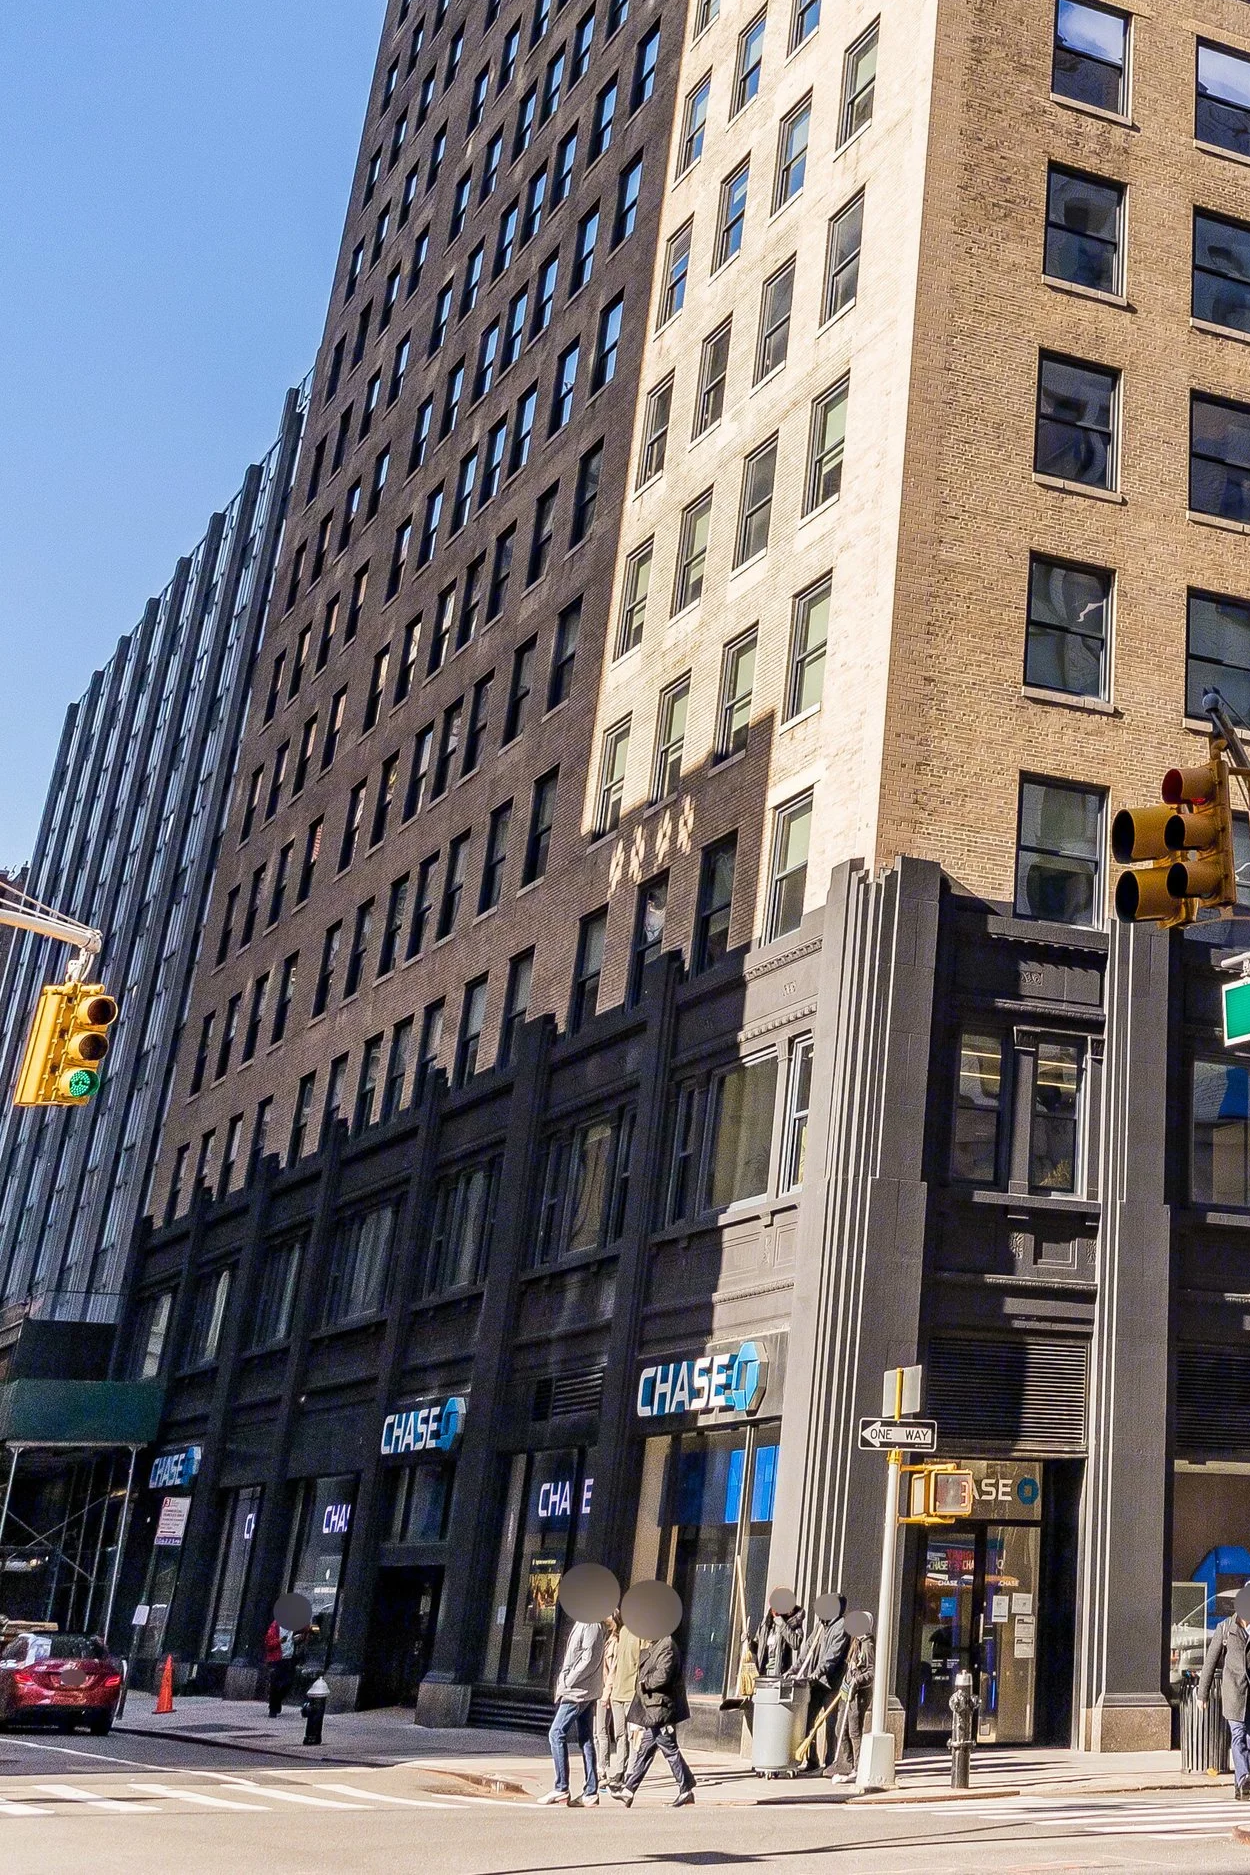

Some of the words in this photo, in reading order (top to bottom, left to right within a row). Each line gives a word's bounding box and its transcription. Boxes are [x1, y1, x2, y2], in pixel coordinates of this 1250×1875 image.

[637, 1353, 732, 1417] CHASE
[380, 1406, 441, 1455] CHASE
[870, 1428, 893, 1440] ONE
[905, 1429, 929, 1441] WAY
[149, 1452, 187, 1489] CHASE
[538, 1478, 595, 1517] CHAE
[322, 1504, 352, 1534] CHA
